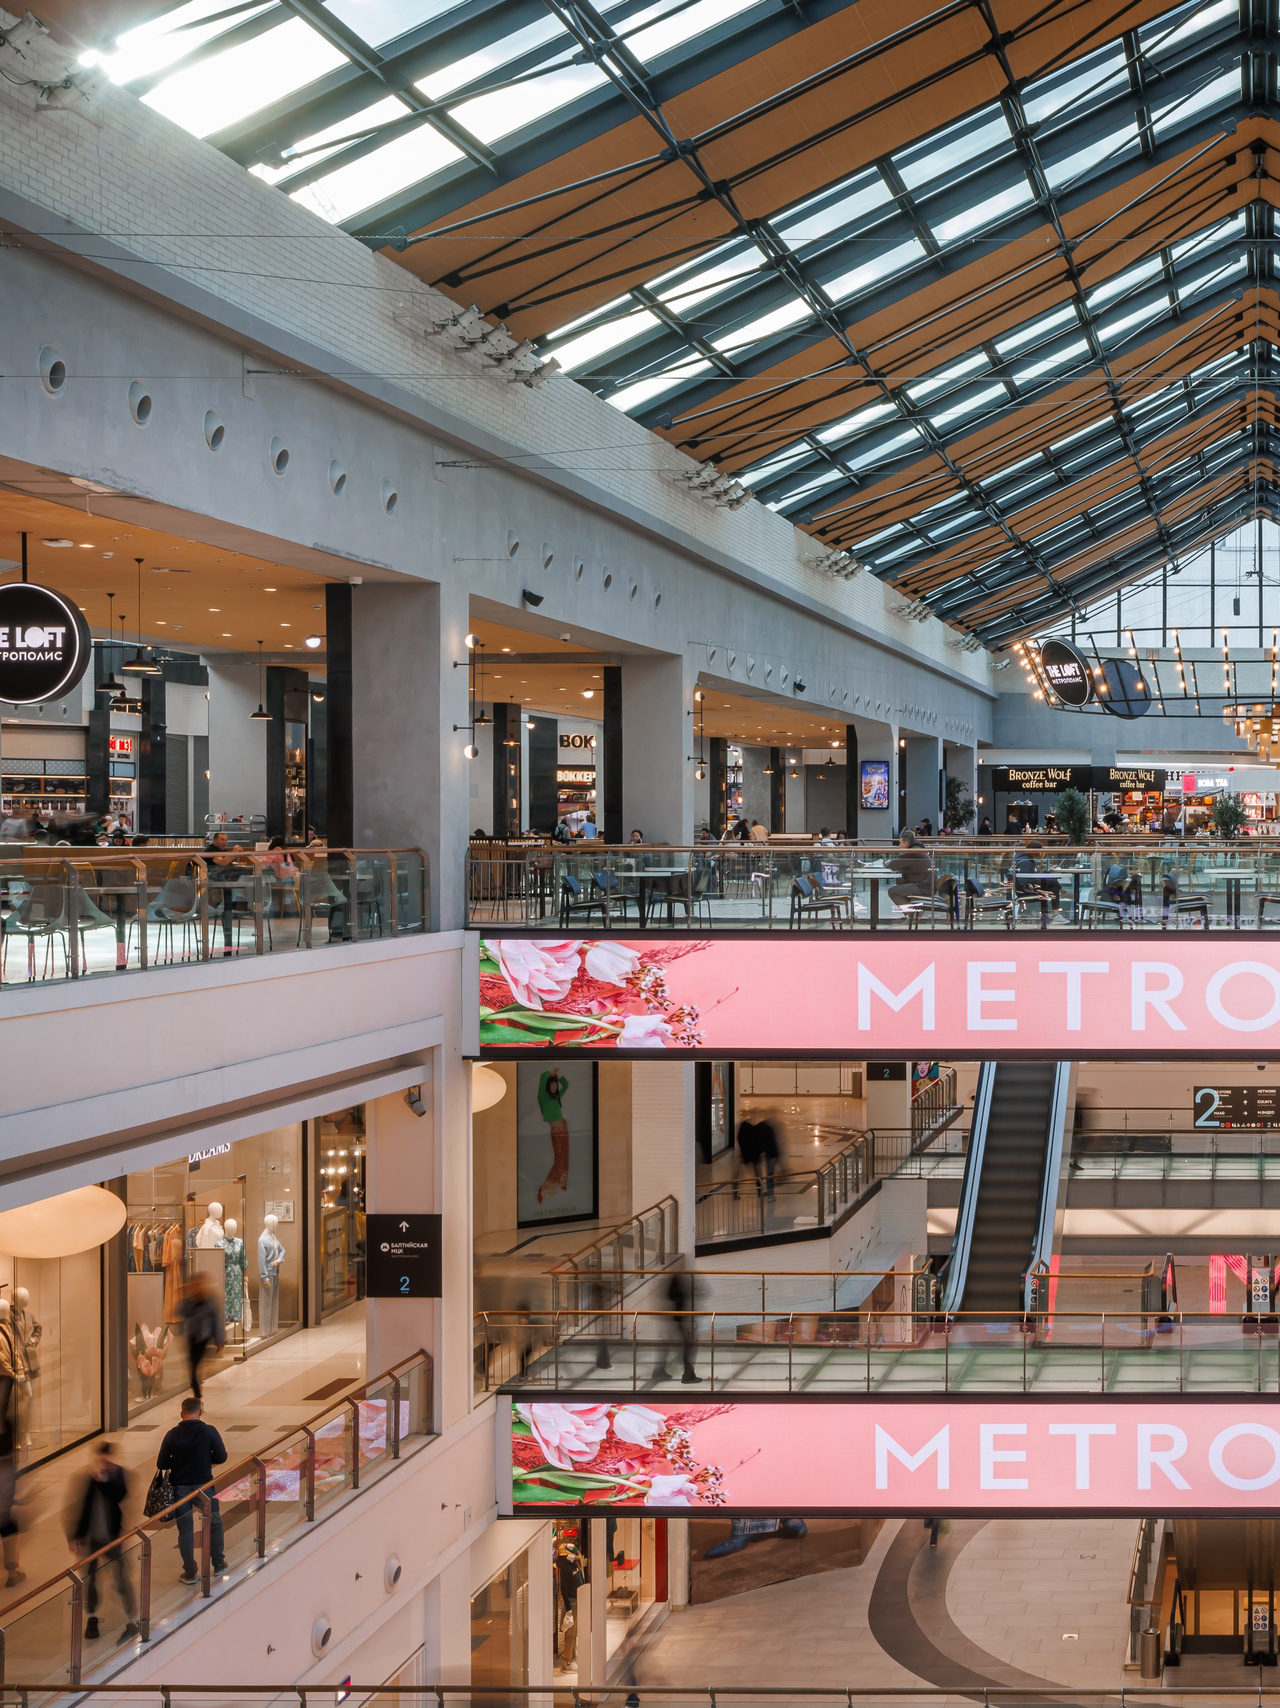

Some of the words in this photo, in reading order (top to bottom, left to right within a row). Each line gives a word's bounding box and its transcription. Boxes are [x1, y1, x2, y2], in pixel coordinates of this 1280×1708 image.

[15, 626, 66, 648] LOFT
[0, 651, 63, 661] РОПОЛИС
[1045, 664, 1061, 678] THE
[1059, 662, 1080, 677] LOFT
[1009, 769, 1046, 781] BRONZE
[1109, 768, 1137, 780] BRONZE
[1022, 780, 1043, 788] coffee
[1044, 780, 1057, 788] bar
[1119, 780, 1135, 788] coffee
[1136, 781, 1145, 789] bar
[883, 1068, 890, 1078] 2
[1195, 1088, 1220, 1127] 2
[400, 1276, 410, 1291] 2
